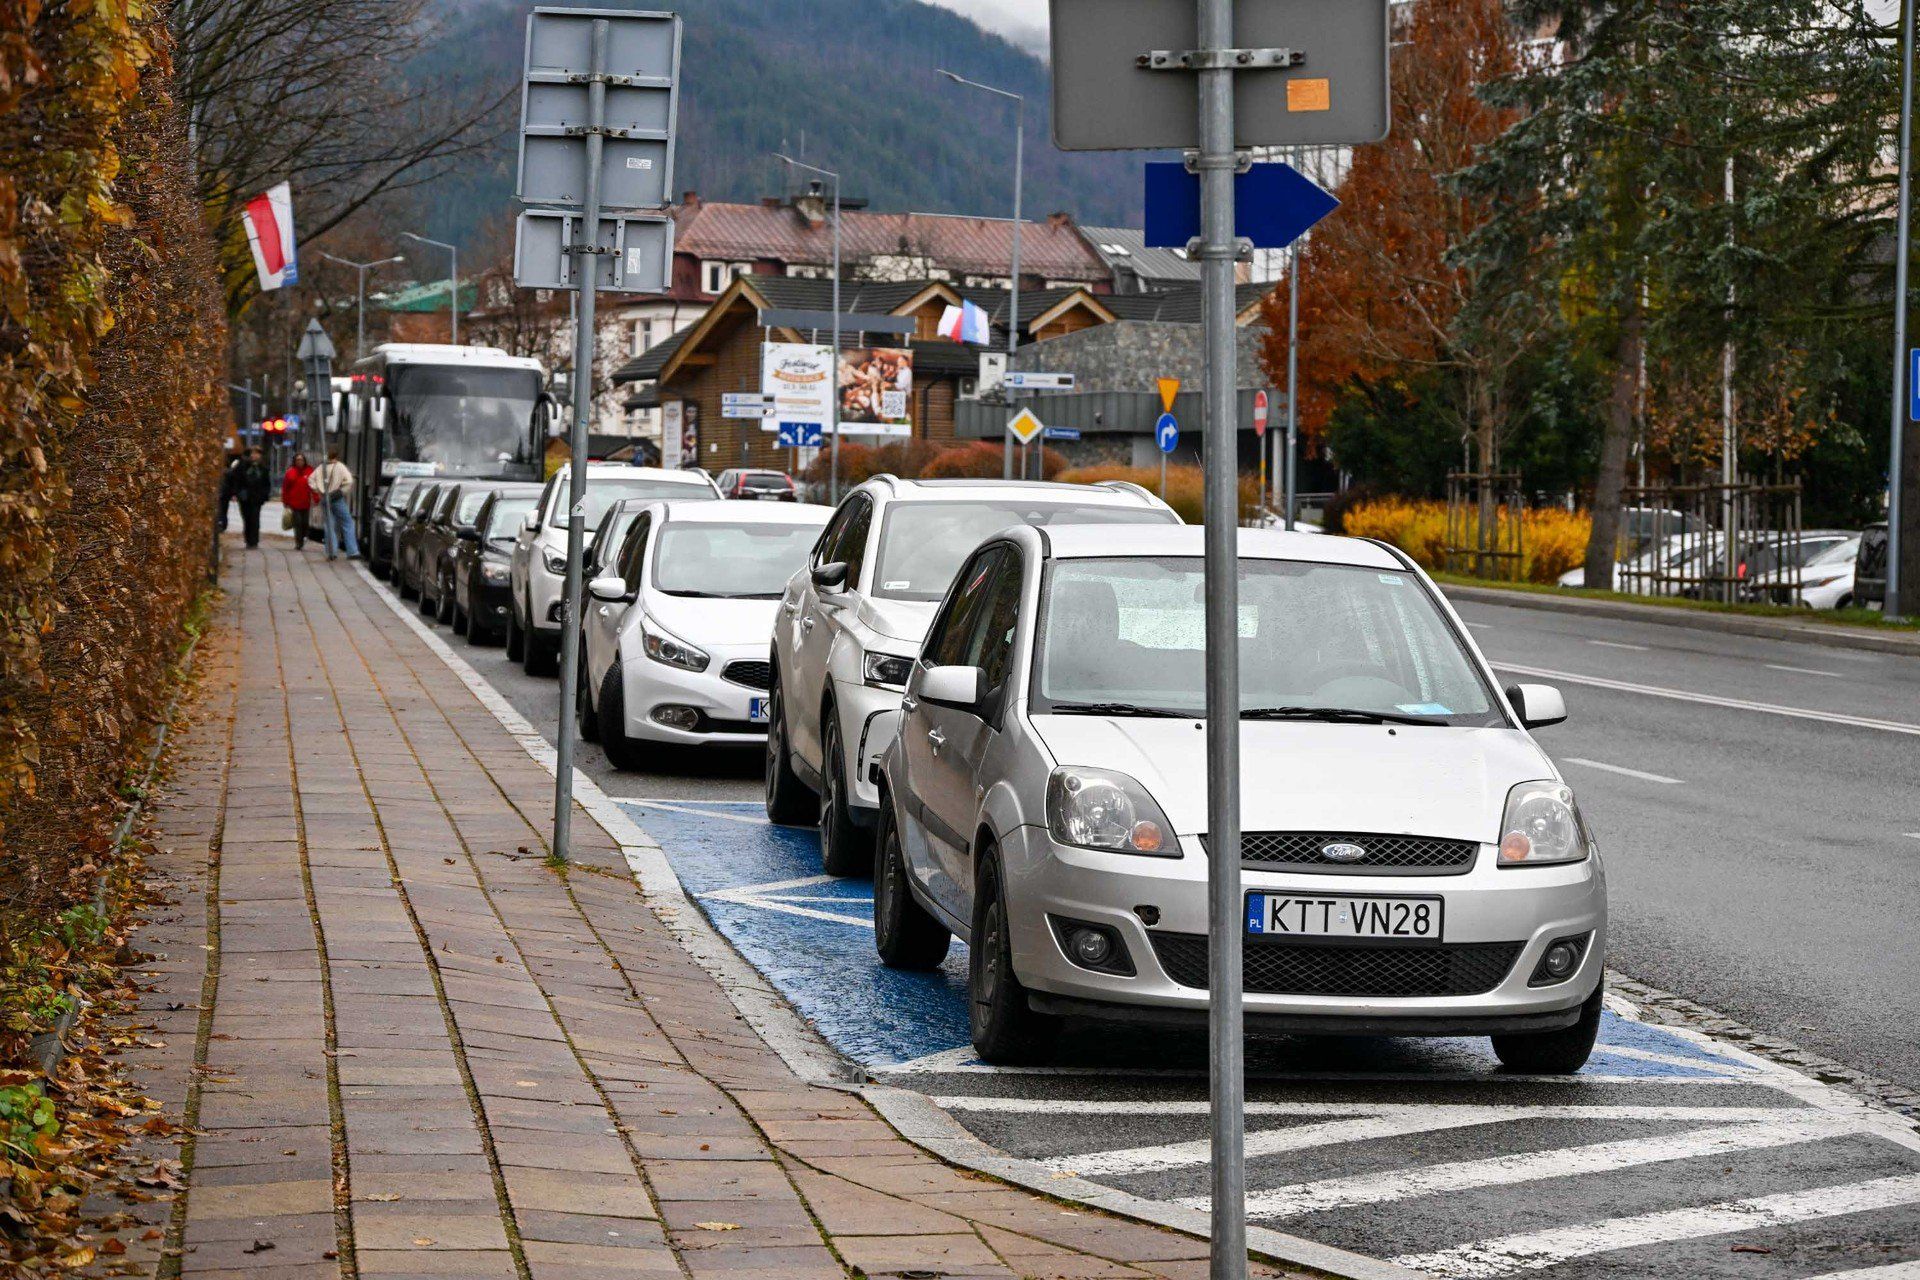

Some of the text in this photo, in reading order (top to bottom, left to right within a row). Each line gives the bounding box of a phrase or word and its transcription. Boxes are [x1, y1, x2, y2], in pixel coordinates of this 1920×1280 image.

[1249, 918, 1262, 928] PL
[1270, 898, 1431, 935] KTT VN28
